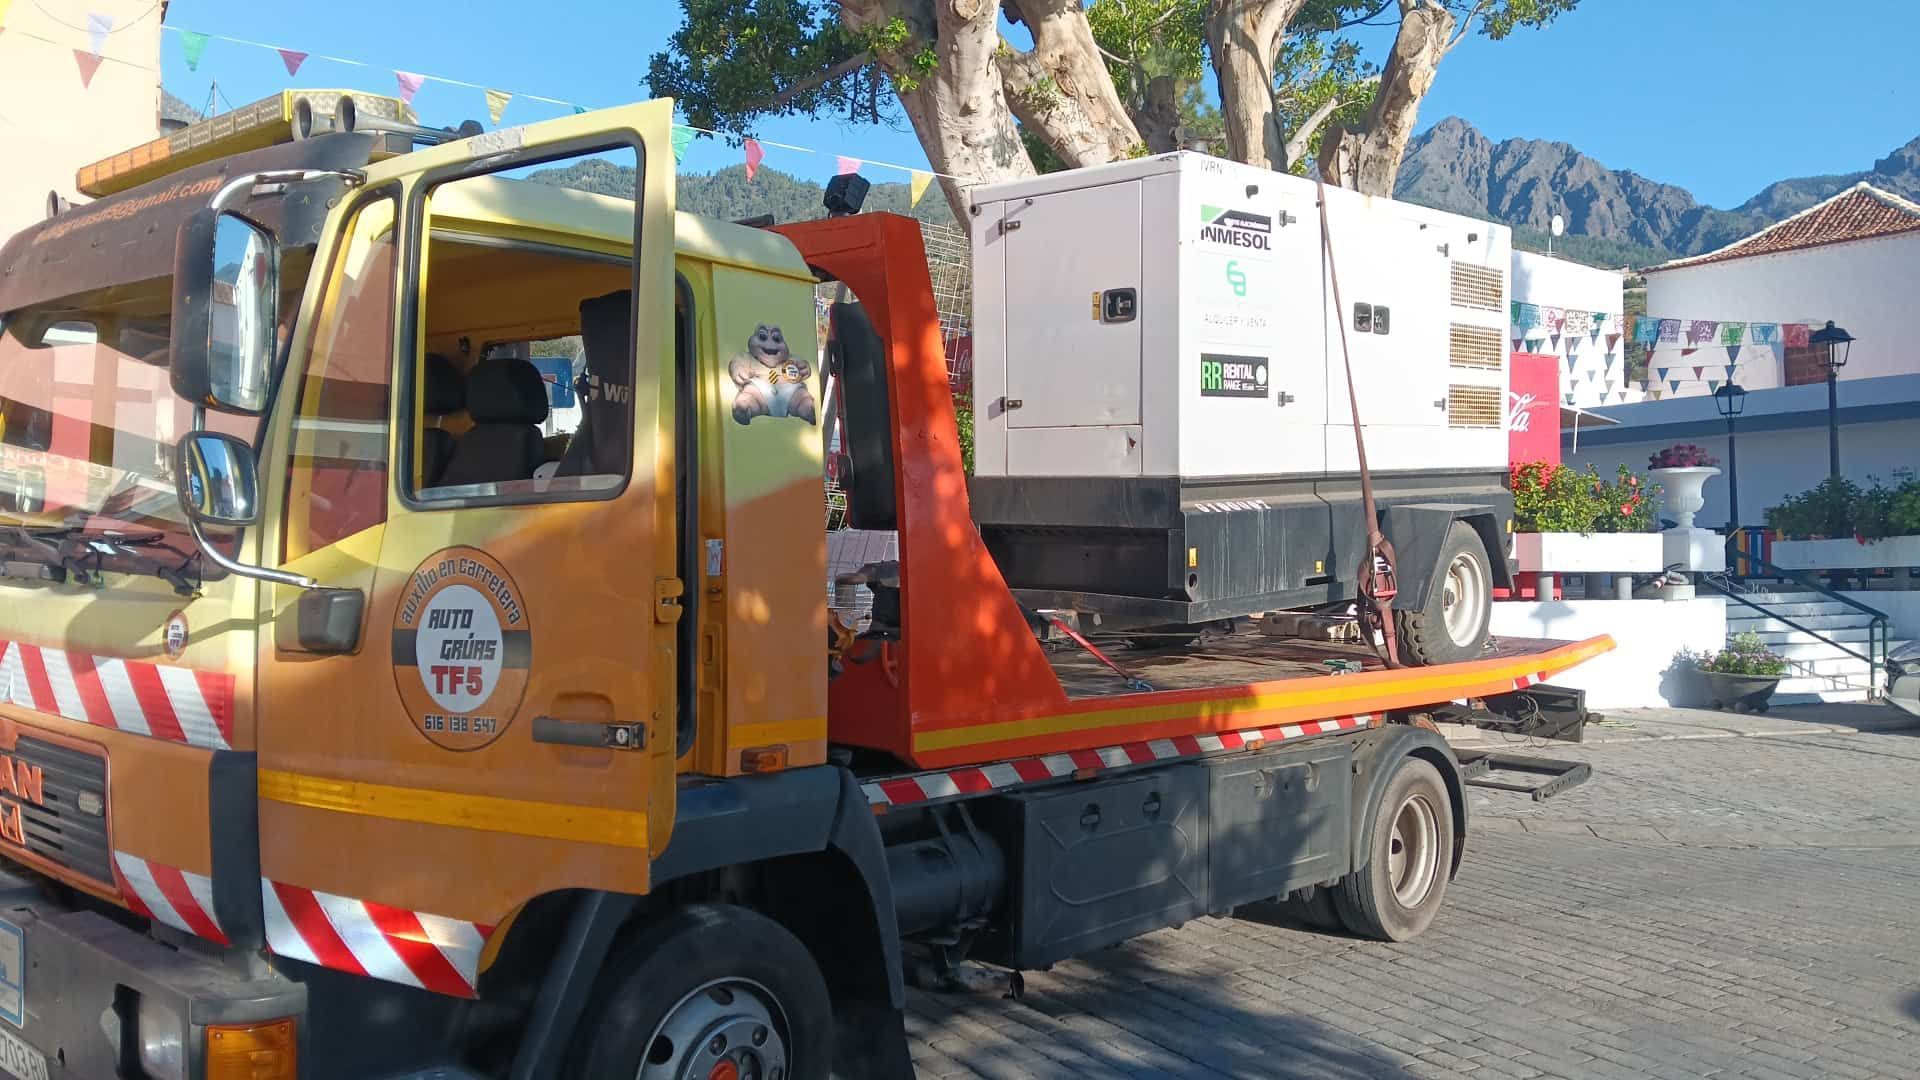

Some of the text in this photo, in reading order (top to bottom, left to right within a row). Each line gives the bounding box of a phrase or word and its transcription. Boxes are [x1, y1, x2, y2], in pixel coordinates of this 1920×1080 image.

[1200, 226, 1271, 250] INMESOL
[1201, 360, 1222, 390] RR
[1223, 363, 1254, 379] RENTAL
[439, 559, 456, 577] en
[459, 557, 521, 624] carretera
[428, 608, 474, 629] AUTO
[440, 632, 498, 660] GRÚAS
[430, 665, 484, 696] TF5
[424, 714, 444, 731] 616
[473, 717, 496, 733] 547
[0, 754, 43, 805] AN
